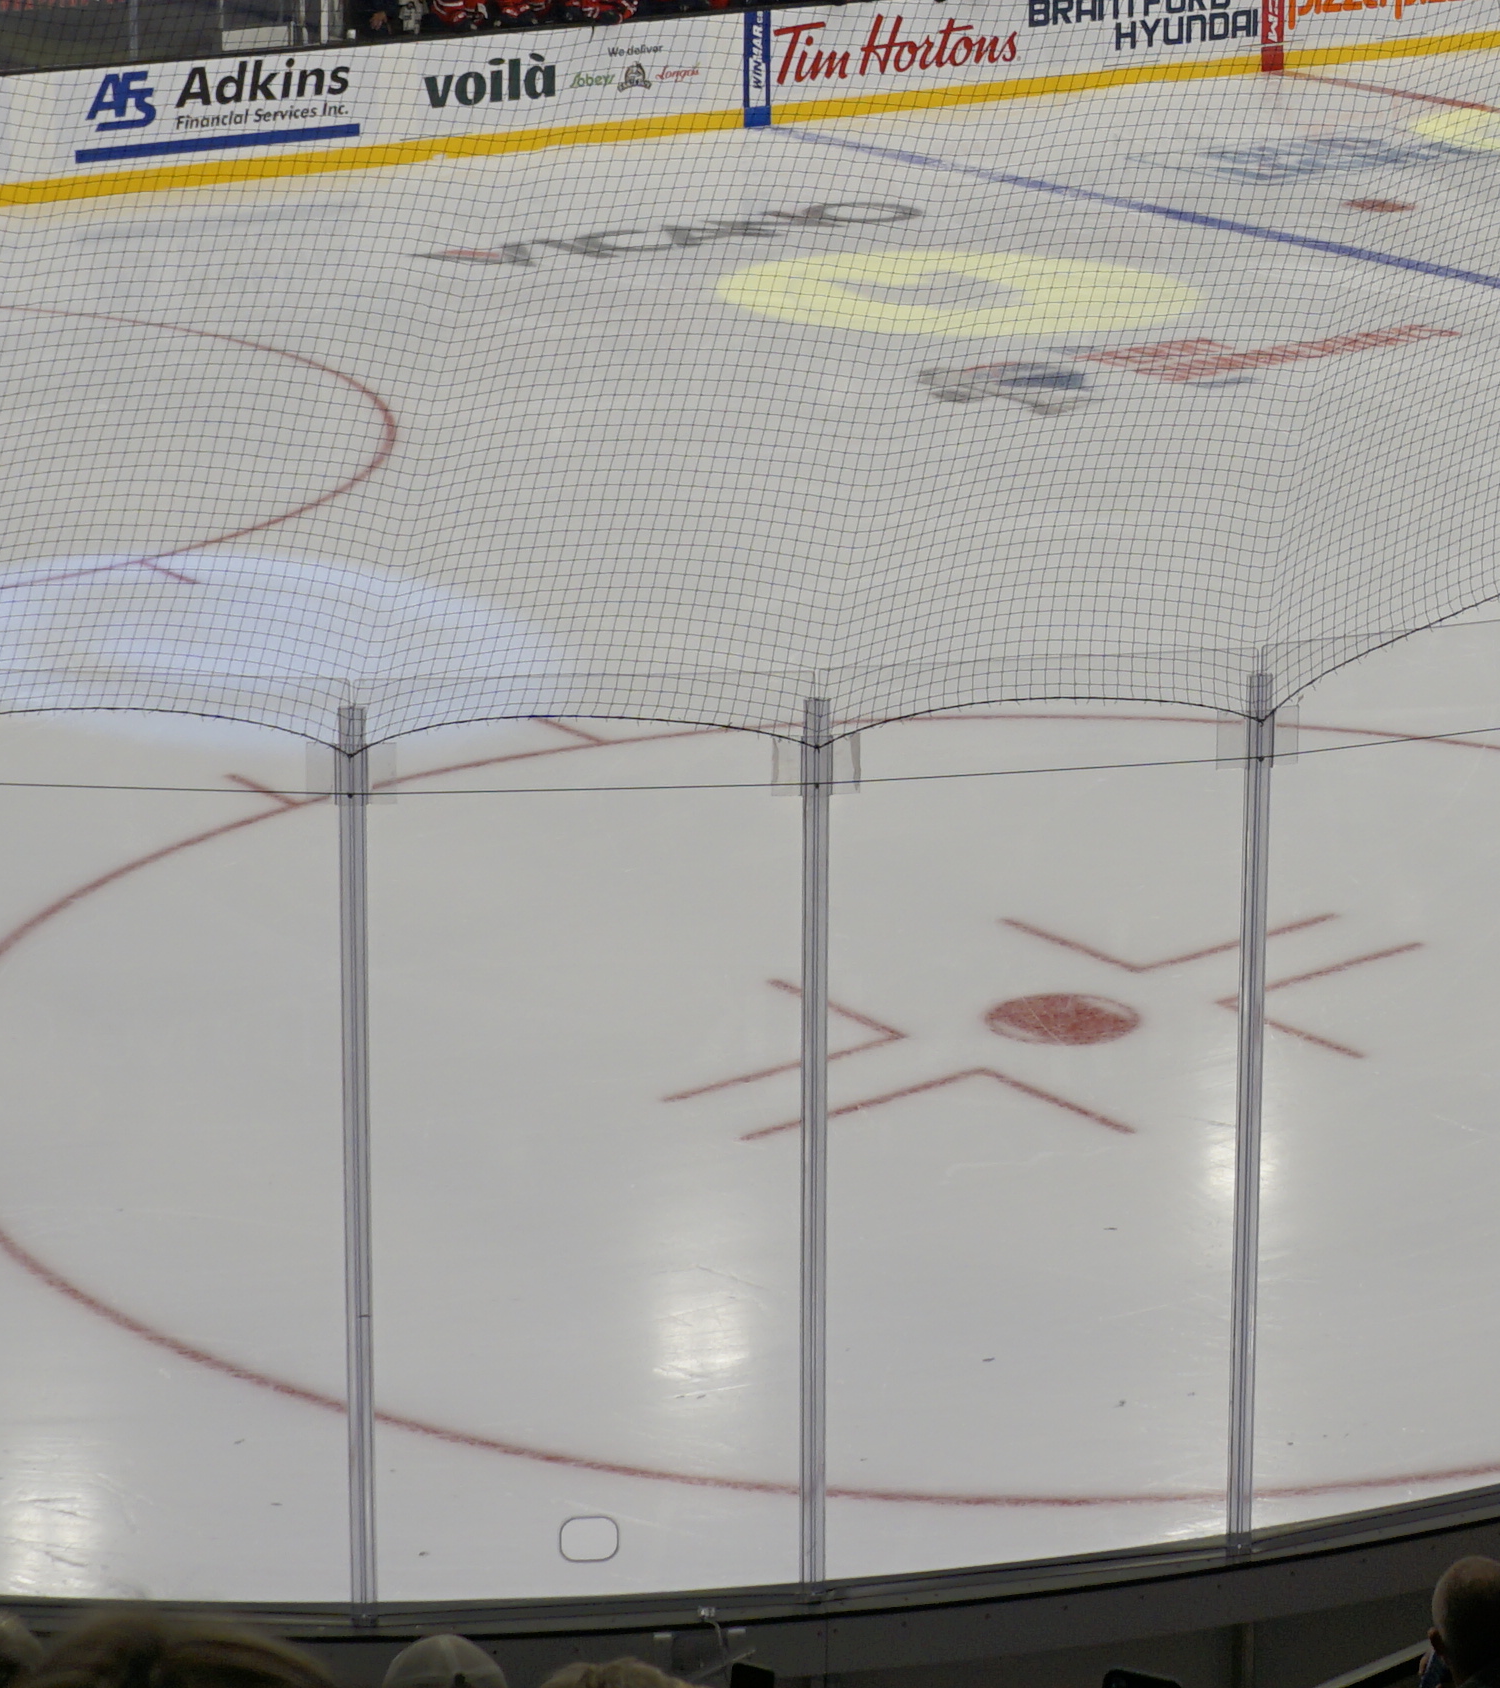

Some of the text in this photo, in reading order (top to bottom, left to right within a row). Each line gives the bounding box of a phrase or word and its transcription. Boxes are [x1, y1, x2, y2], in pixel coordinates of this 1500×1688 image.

[773, 13, 1020, 87] Tim Hortons
[1114, 7, 1259, 51] HYUNDAI
[175, 58, 351, 111] Adkins
[424, 52, 557, 109] voilà
[175, 101, 350, 131] Financial Services Inc.
